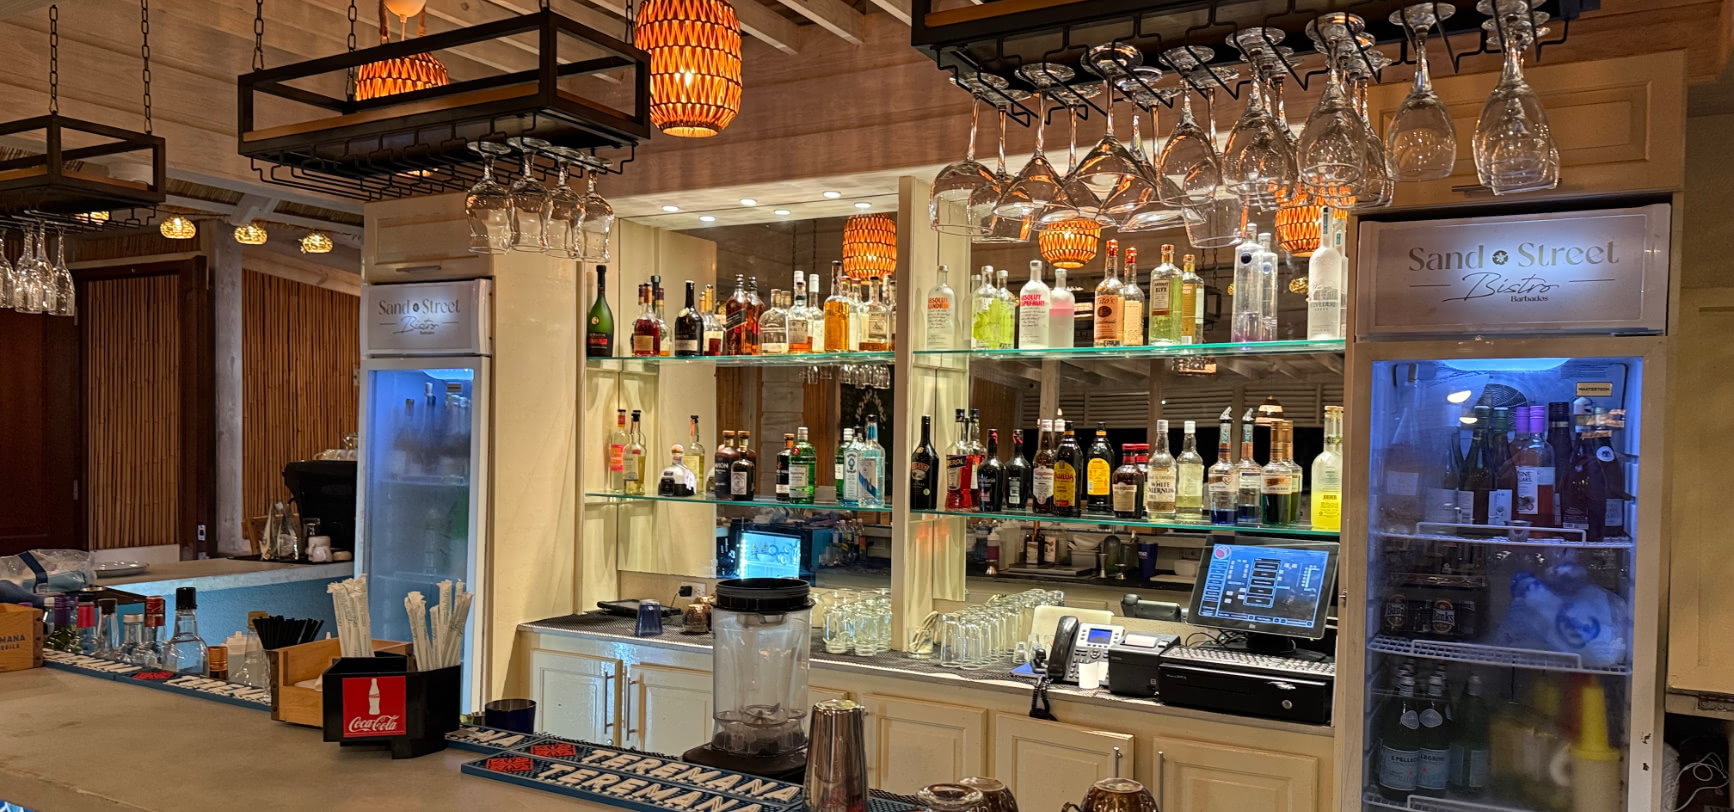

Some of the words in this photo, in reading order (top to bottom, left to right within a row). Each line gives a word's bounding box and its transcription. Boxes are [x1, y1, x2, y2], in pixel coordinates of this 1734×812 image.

[1408, 245, 1484, 271] Sand
[1517, 241, 1620, 267] Street
[1441, 271, 1560, 302] Bistro
[379, 300, 410, 315] Sand
[422, 299, 460, 314] Street
[393, 316, 439, 334] Bistro
[0, 634, 25, 643] MANA
[349, 715, 400, 732] Coca-Cola
[582, 750, 801, 801] TEREMANA
